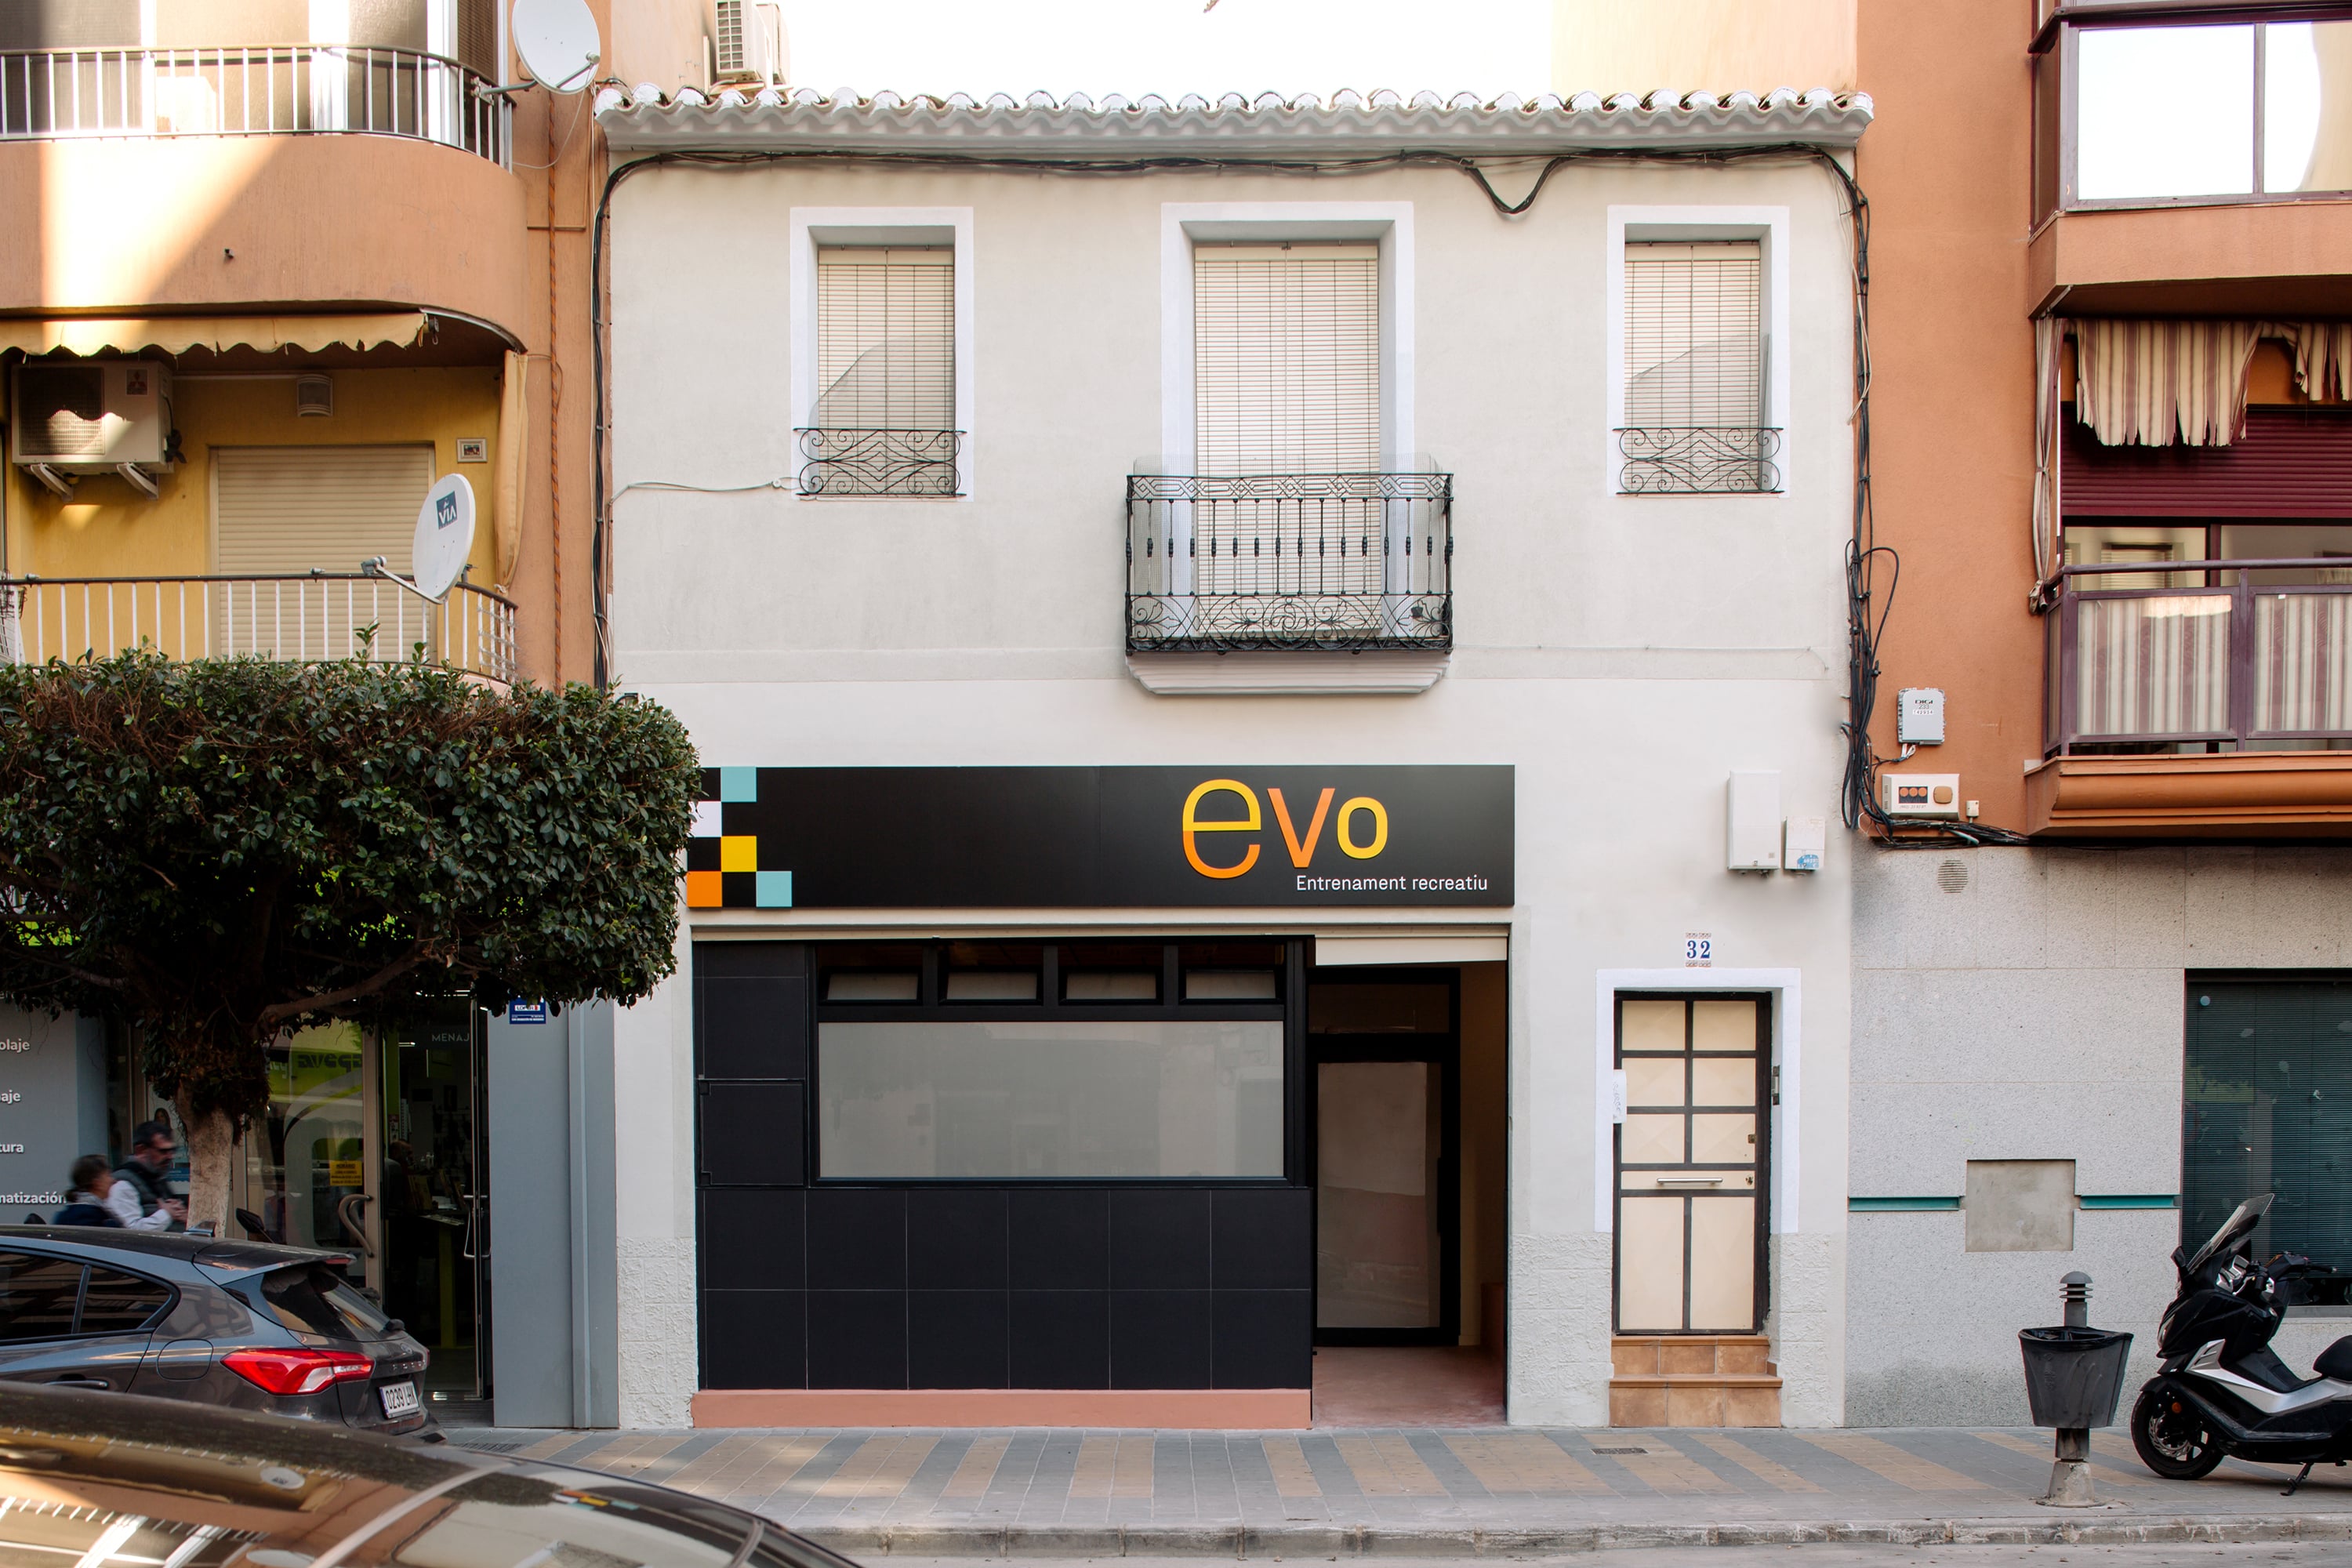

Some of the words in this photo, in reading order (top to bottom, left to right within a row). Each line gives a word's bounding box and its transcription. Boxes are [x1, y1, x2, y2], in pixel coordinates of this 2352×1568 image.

[1182, 779, 1388, 879] evo
[1296, 875, 1406, 891] Entrenament
[1412, 874, 1488, 891] recreatiu
[1686, 940, 1711, 959] 32
[0, 1090, 21, 1105] aje
[386, 1388, 405, 1410] 0239
